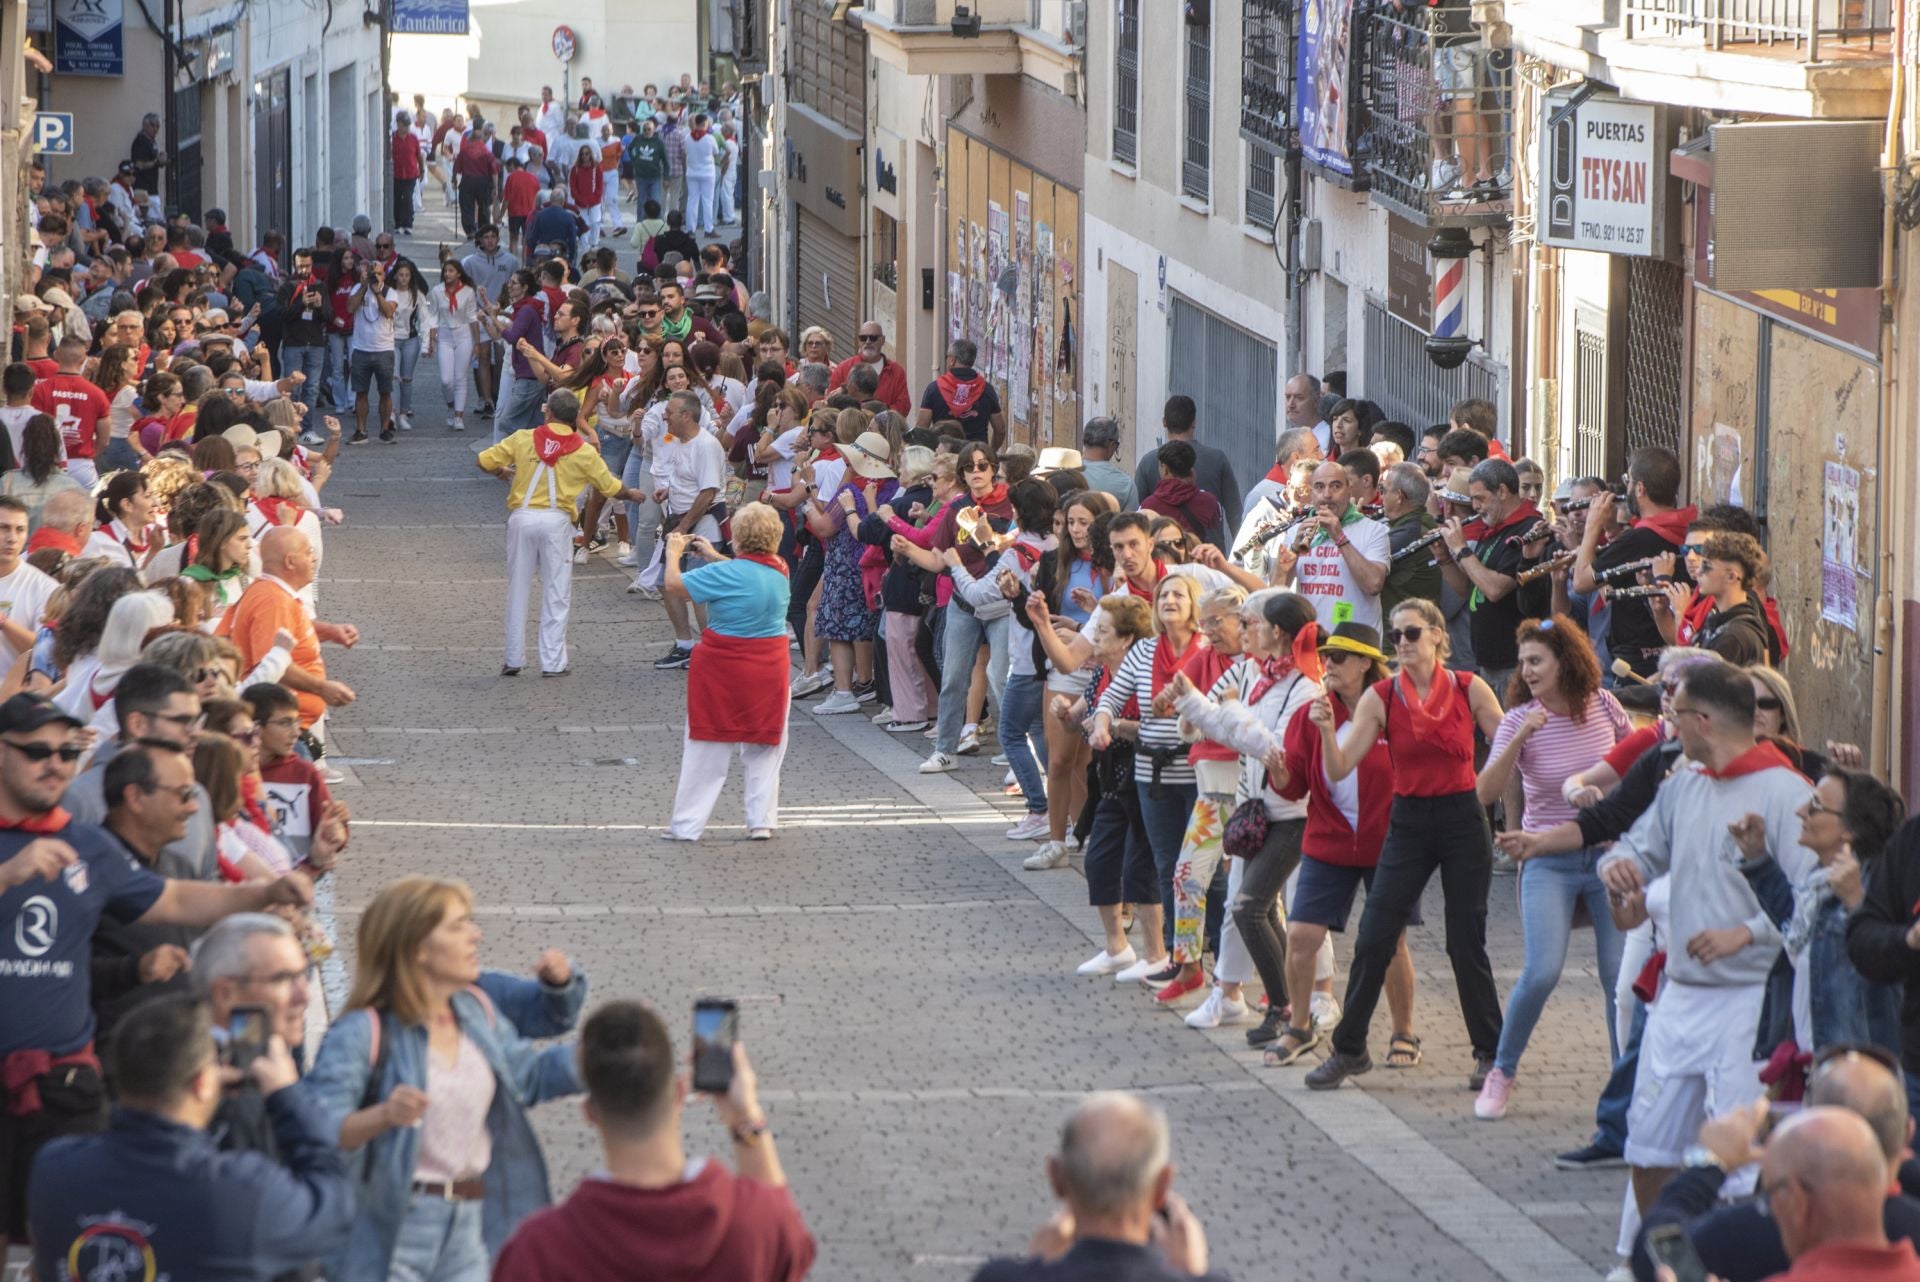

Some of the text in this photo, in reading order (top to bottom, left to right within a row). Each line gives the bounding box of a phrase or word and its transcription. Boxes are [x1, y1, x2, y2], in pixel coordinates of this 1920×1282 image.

[393, 12, 466, 33] Cantábrico
[39, 116, 64, 149] P
[1587, 120, 1645, 143] PUERTAS
[1582, 156, 1647, 205] TEYSAN
[1581, 222, 1644, 244] TFNO. 921 14 25 37
[1316, 545, 1345, 558] CUL
[1304, 563, 1340, 577] ES DEL
